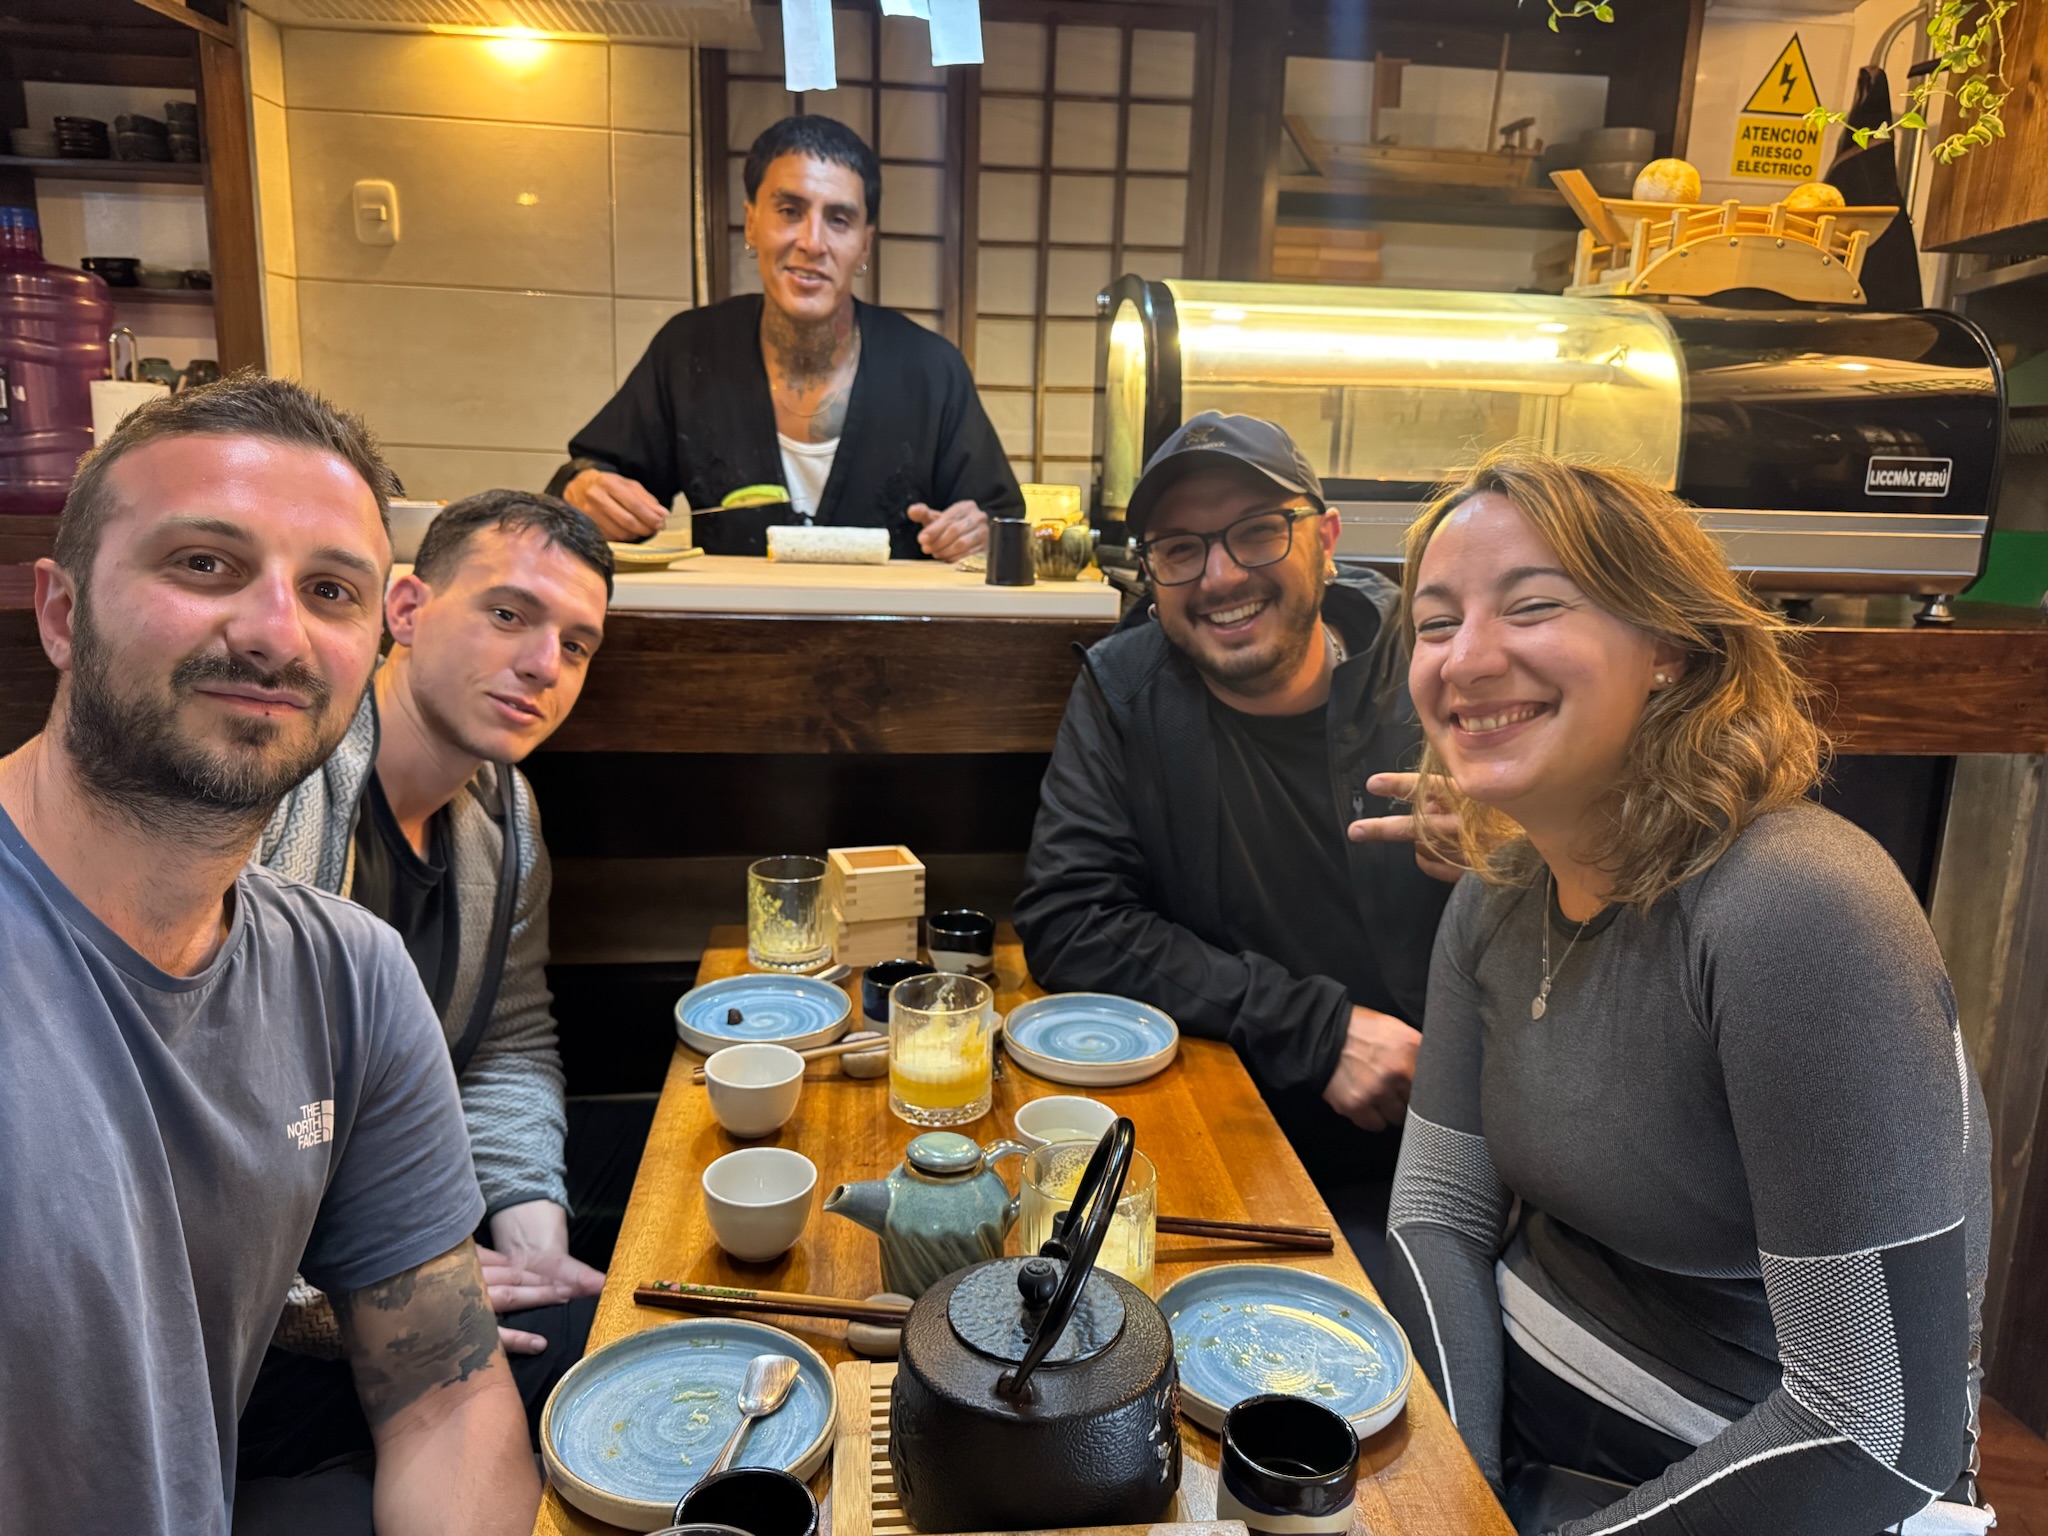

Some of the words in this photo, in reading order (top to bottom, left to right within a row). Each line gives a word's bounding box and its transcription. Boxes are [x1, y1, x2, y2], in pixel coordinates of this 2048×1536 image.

[1751, 145, 1802, 160] RIESGO
[1736, 160, 1812, 177] ELECTRICO
[1917, 468, 1947, 487] PERÚ
[300, 1101, 321, 1119] THE
[287, 1115, 322, 1139] NORTH
[297, 1129, 322, 1151] FACE
